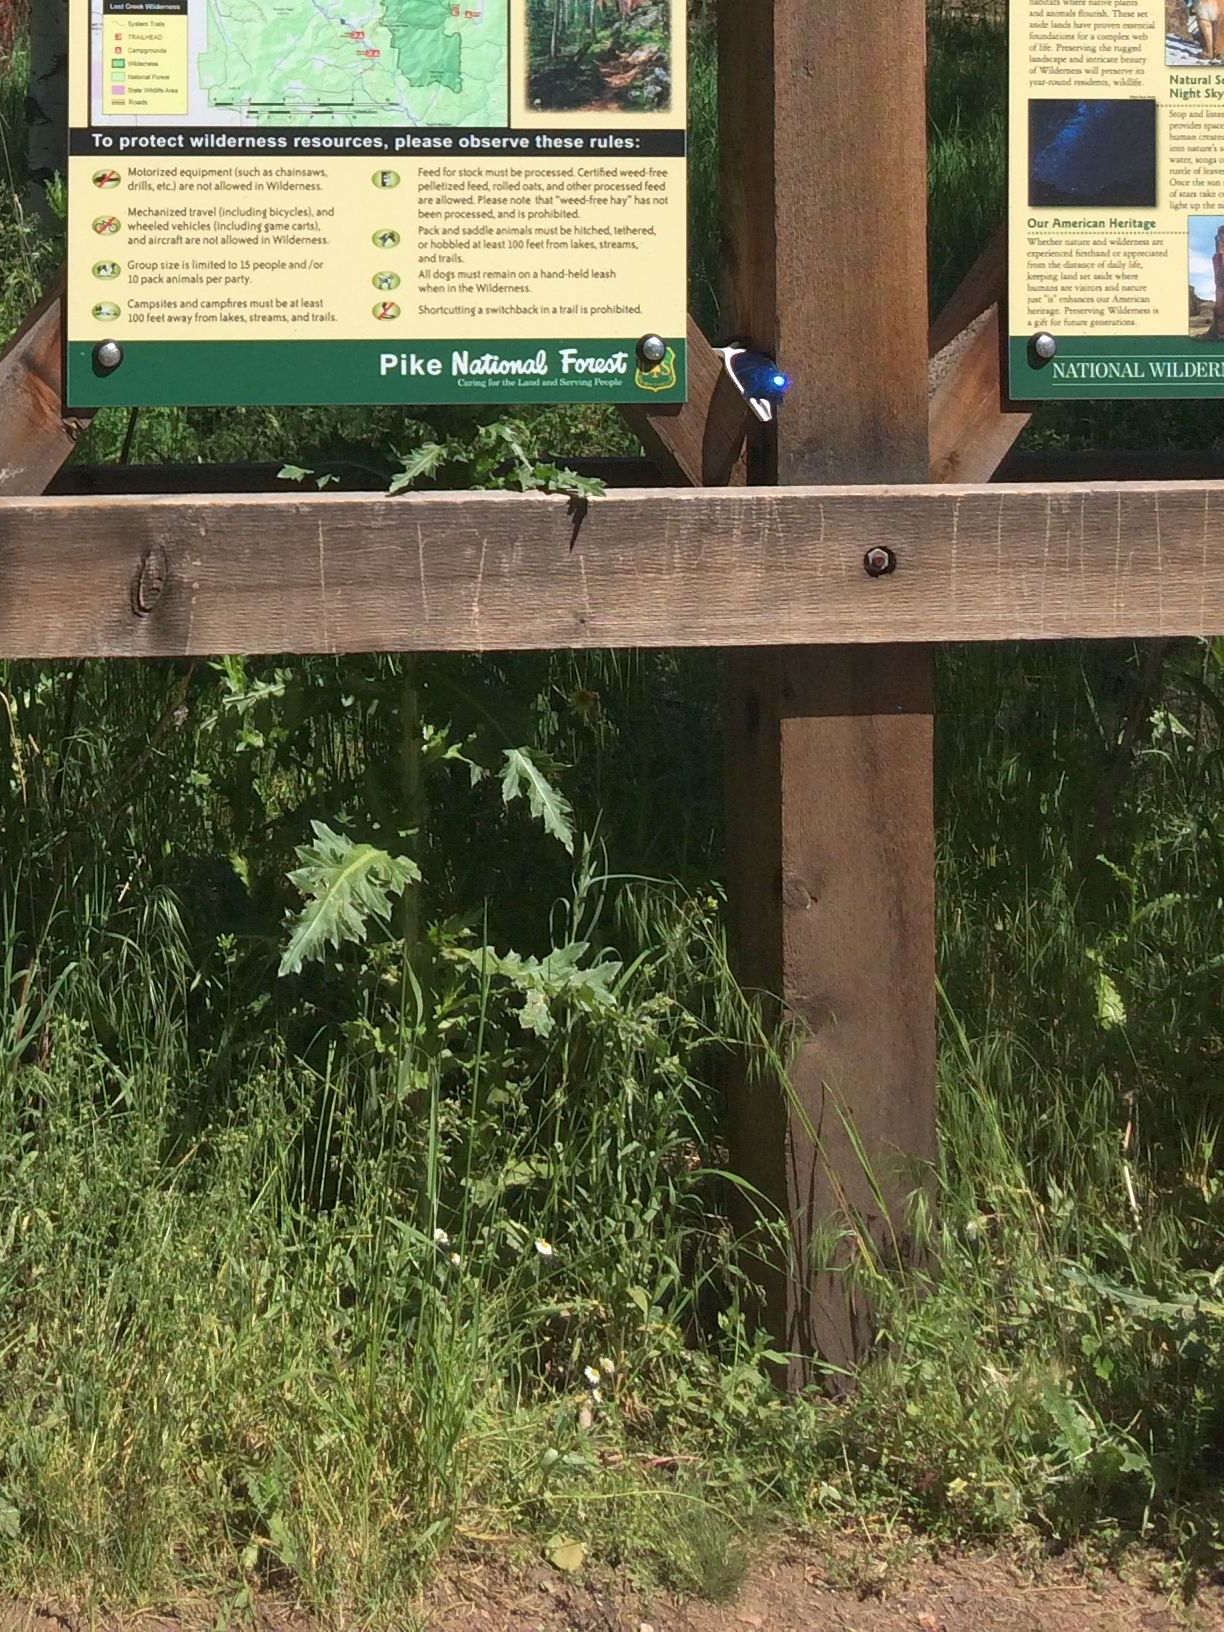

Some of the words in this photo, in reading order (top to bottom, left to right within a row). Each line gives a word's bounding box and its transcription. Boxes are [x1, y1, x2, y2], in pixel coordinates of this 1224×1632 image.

[1169, 74, 1211, 85] Natural
[1170, 88, 1201, 101] Night
[91, 133, 113, 147] To
[119, 134, 184, 150] protect
[189, 134, 287, 148] wilderness
[294, 137, 388, 150] resources,
[395, 134, 453, 151] please
[459, 134, 530, 148] observe
[535, 135, 584, 148] these
[590, 135, 640, 148] rules:
[128, 167, 177, 177] Motorized
[179, 168, 232, 179] equipment
[262, 169, 273, 177] as
[418, 167, 441, 177] Feed
[443, 167, 456, 177] for
[458, 167, 483, 177] stock
[485, 168, 508, 177] must
[510, 167, 523, 177] be
[577, 167, 618, 177] Certified
[179, 183, 195, 191] are
[196, 182, 212, 191] not
[214, 181, 252, 191] allowed
[255, 182, 264, 190] in
[128, 207, 187, 217] Mechanized
[189, 207, 216, 217] travel
[316, 207, 335, 217] and
[127, 221, 169, 231] wheeled
[171, 221, 211, 231] vehicles
[264, 223, 290, 233] game
[1027, 218, 1049, 228] Our
[1052, 218, 1105, 228] American
[1109, 218, 1156, 230] Heritage
[127, 260, 159, 272] Group
[160, 261, 180, 270] size
[182, 261, 190, 270] is
[192, 260, 226, 270] limited
[228, 261, 238, 270] to
[240, 260, 251, 270] 15
[252, 260, 287, 271] people
[288, 259, 307, 269] and
[128, 274, 139, 284] 10
[141, 274, 164, 286] pack
[166, 273, 204, 284] animals
[206, 276, 223, 286] per
[418, 269, 431, 279] All
[432, 269, 456, 282] dogs
[457, 270, 481, 279] must
[483, 271, 516, 279] remain
[518, 271, 531, 279] on
[532, 271, 538, 279] a
[591, 269, 616, 279] leash
[418, 283, 445, 293] when
[458, 283, 474, 293] the
[127, 299, 178, 311] Campsites
[179, 298, 198, 308] and
[200, 298, 248, 310] campfires
[250, 299, 273, 308] must
[275, 298, 288, 308] be
[290, 299, 299, 308] at
[301, 298, 323, 308] least
[128, 313, 145, 323] 100
[146, 312, 165, 323] feet
[167, 315, 193, 325] away
[194, 312, 218, 323] from
[291, 312, 310, 322] and
[380, 354, 442, 376] Pike
[452, 349, 548, 376] National
[558, 348, 629, 374] Forest
[1053, 362, 1145, 378] NATIONAL
[1149, 362, 1224, 377] WILDER
